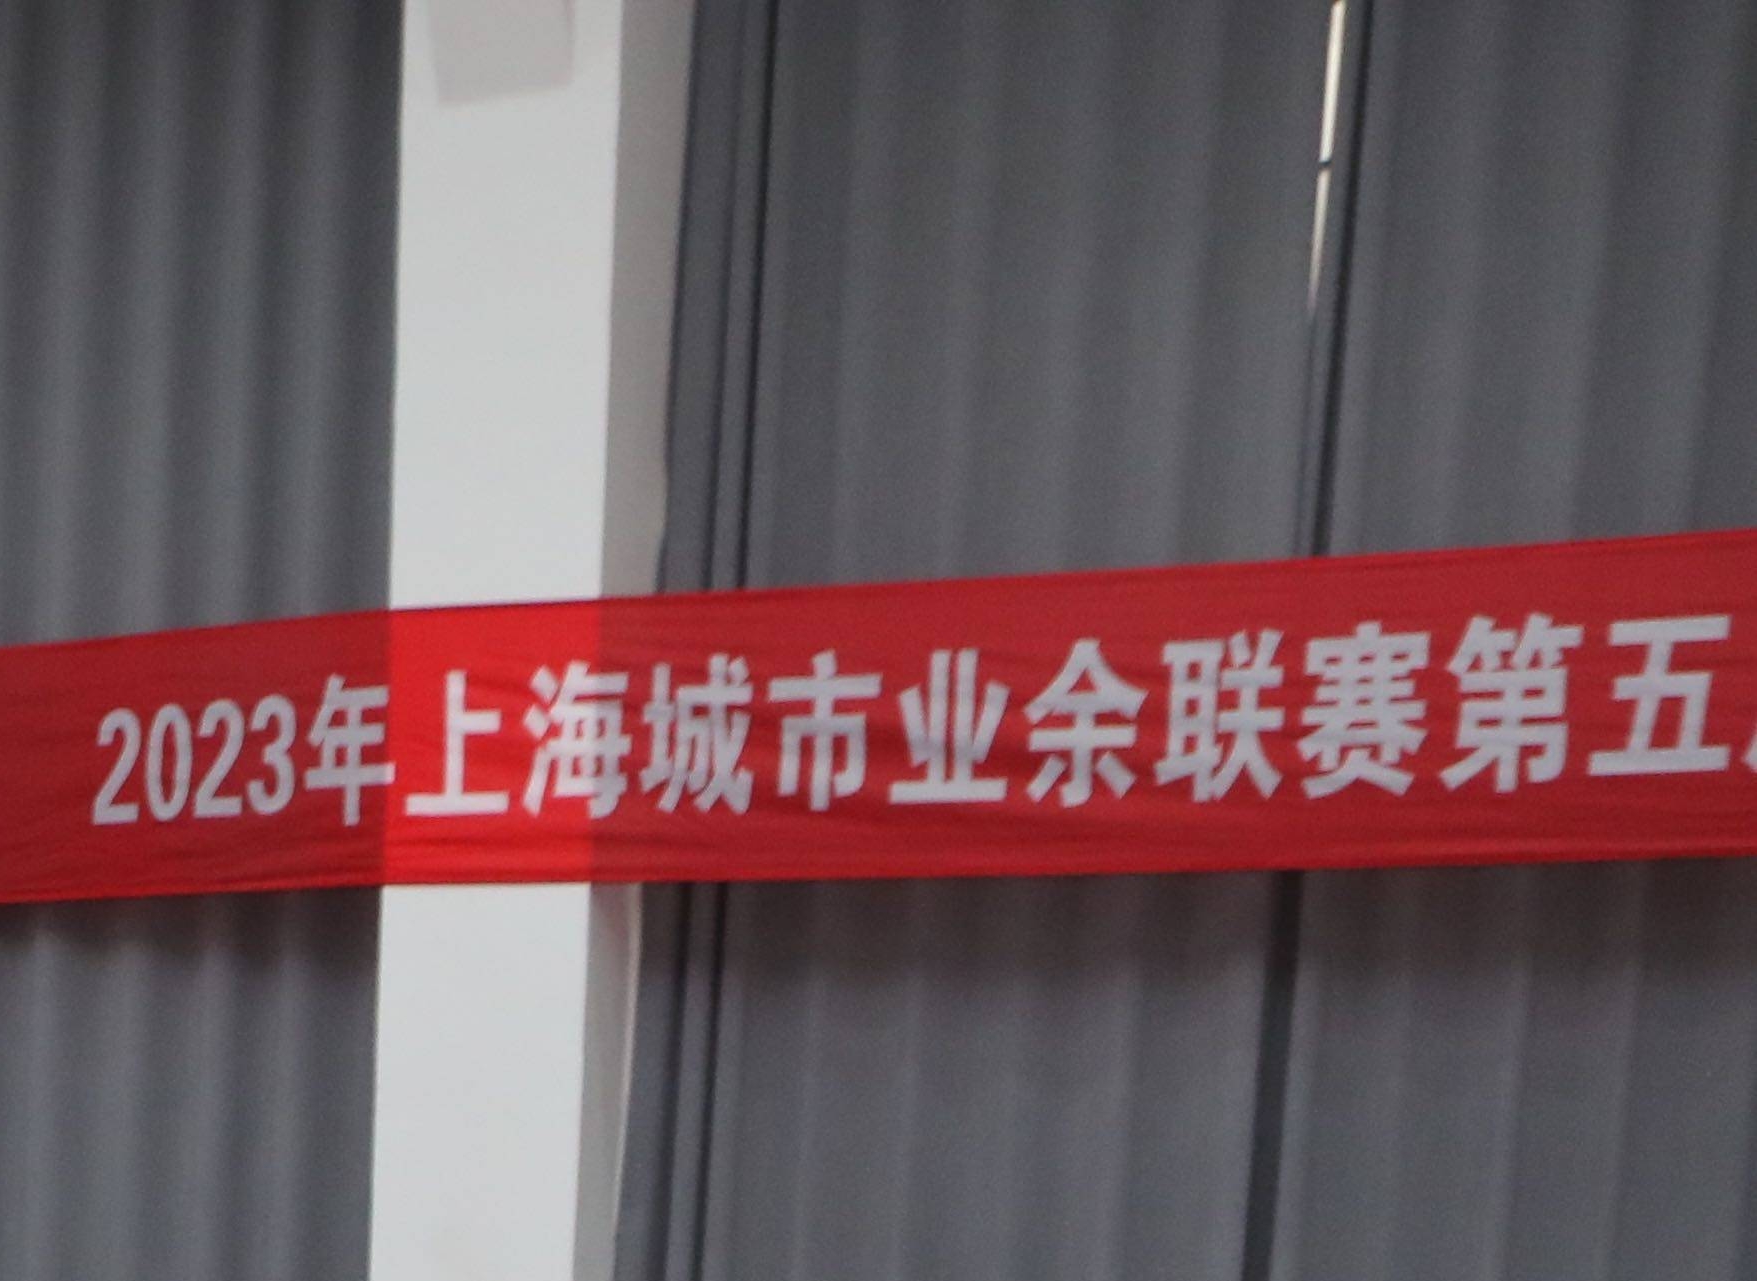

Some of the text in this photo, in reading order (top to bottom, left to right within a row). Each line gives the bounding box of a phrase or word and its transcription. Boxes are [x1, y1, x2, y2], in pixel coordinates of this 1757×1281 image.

[91, 612, 1757, 826] 2023年上海城市业余联赛第五
